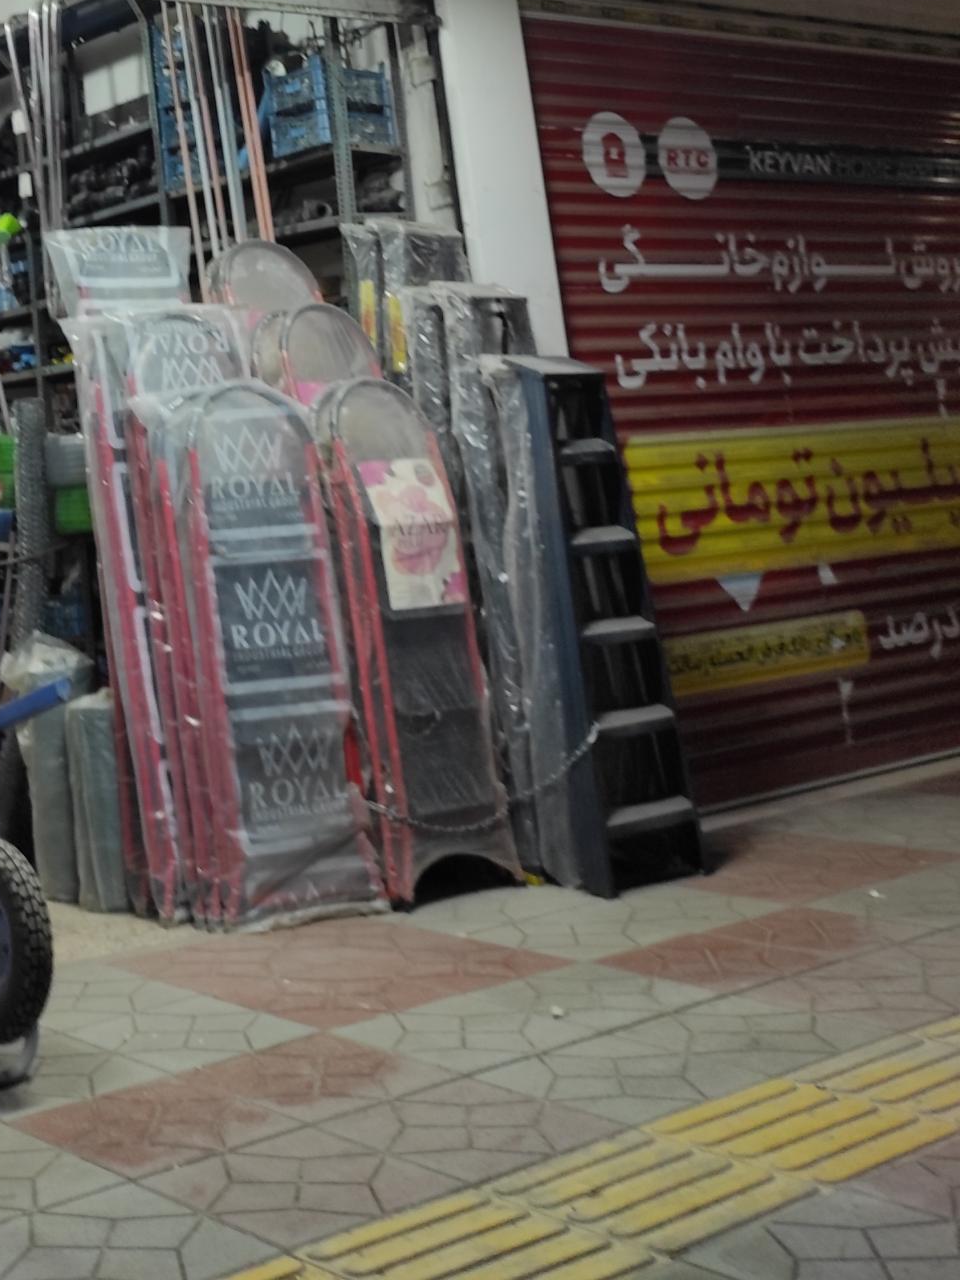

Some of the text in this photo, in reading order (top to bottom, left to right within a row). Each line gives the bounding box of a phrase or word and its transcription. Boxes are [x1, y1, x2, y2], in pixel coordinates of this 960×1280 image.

[745, 145, 833, 176] KEYVAN
[900, 241, 960, 294] روش
[615, 321, 707, 389] بانکی
[211, 472, 300, 500] ROYAL
[657, 438, 960, 556] یلیون تومانی
[230, 618, 324, 649] ROYAL
[249, 775, 348, 808] ROYAL
